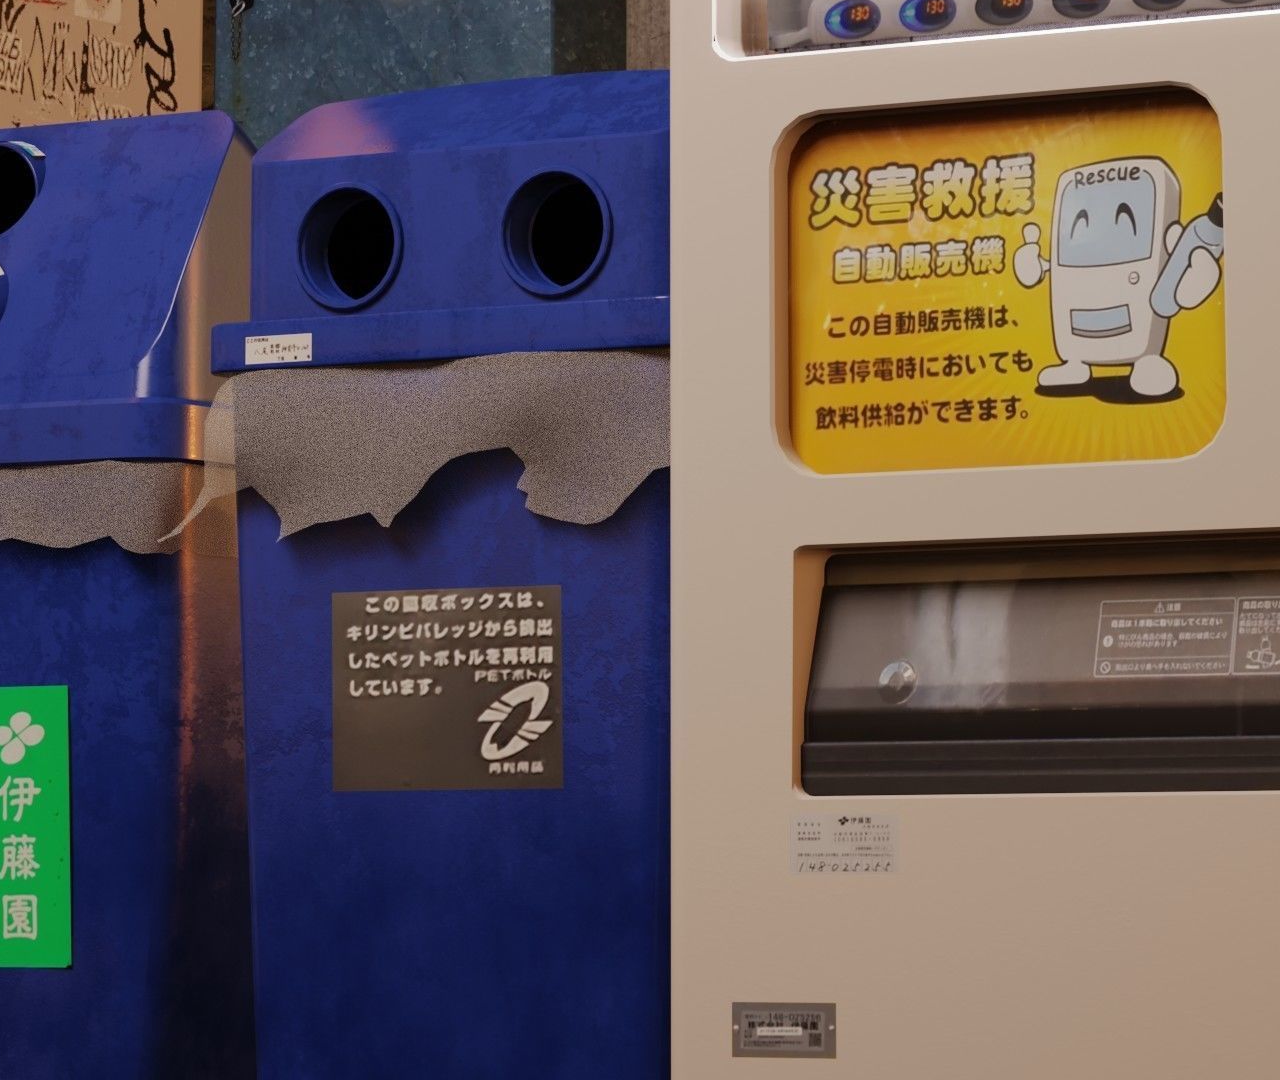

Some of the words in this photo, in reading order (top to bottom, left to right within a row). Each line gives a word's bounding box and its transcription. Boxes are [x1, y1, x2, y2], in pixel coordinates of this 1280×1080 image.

[850, 5, 869, 21] 130
[809, 152, 1035, 231] 災害救援
[1074, 163, 1142, 189] Rescue
[832, 235, 1006, 285] 自動販売機
[827, 304, 1019, 339] この自動販売機は、
[804, 349, 1034, 387] 災害停電時においても
[815, 395, 1030, 431] 飲料供給ができます。
[348, 646, 555, 670] したペットボトルを再利用
[349, 677, 443, 698] しています。
